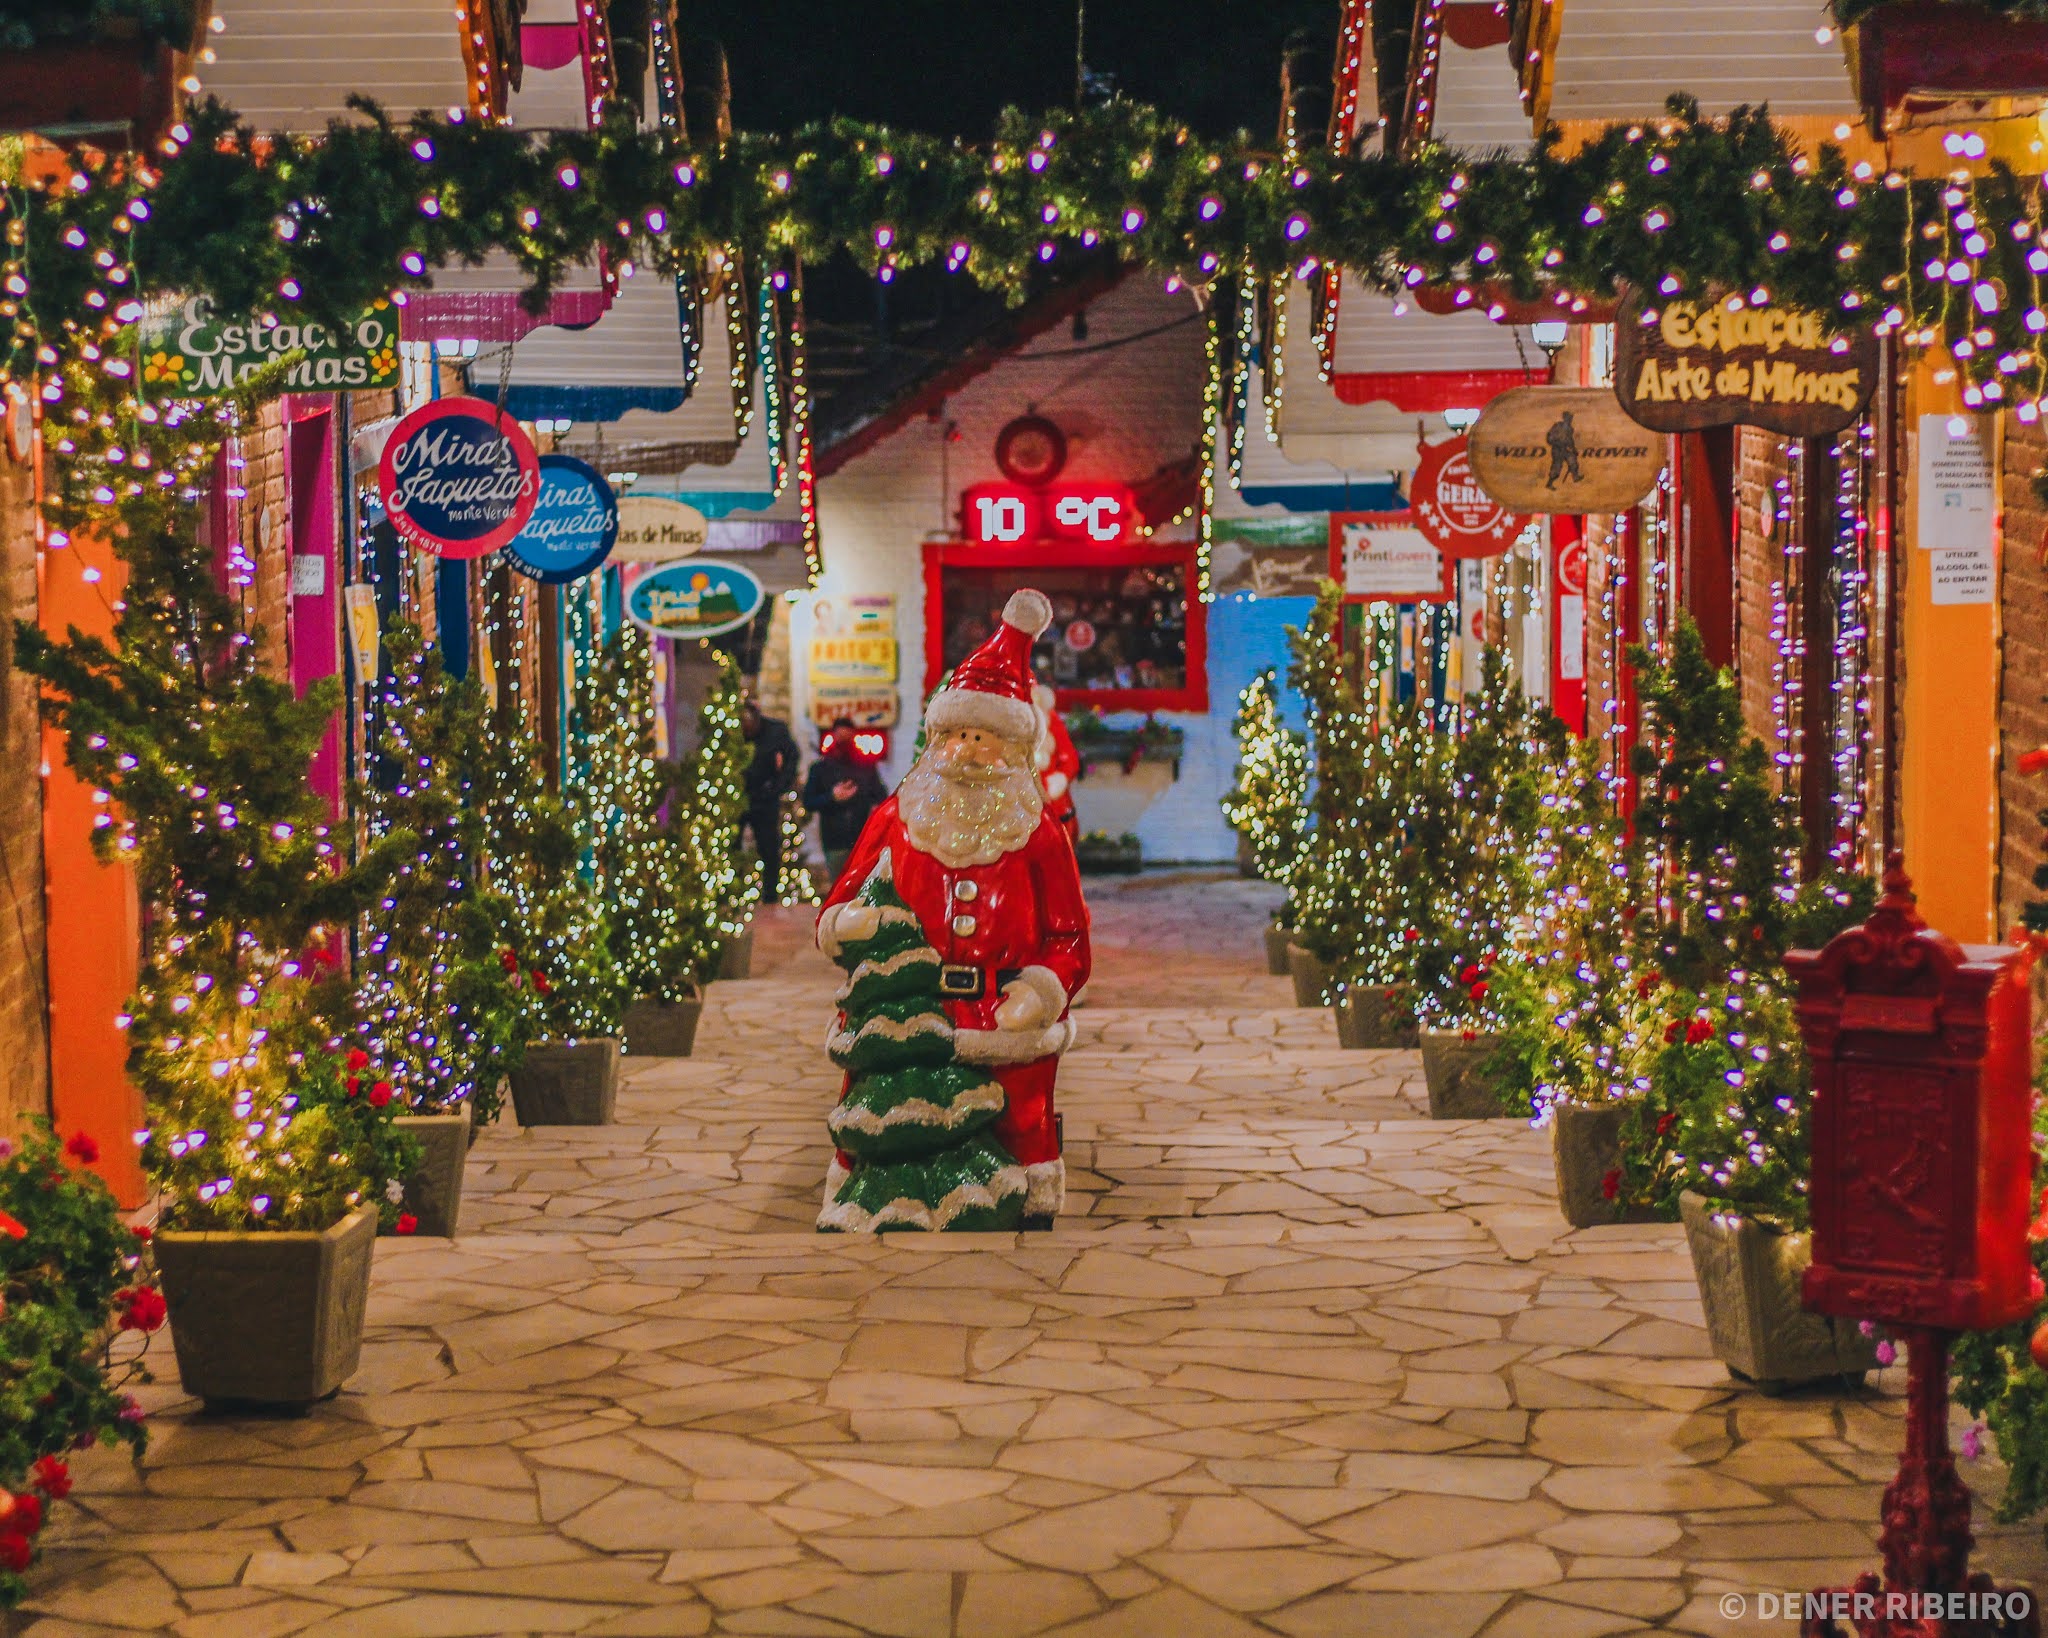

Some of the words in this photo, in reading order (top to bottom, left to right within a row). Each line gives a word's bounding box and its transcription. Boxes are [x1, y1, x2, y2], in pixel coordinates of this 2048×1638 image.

[1635, 356, 1712, 402] Arte
[1715, 361, 1750, 396] de
[1750, 360, 1860, 412] Minas
[1494, 446, 1547, 458] WILD
[1581, 446, 1648, 458] ROVER
[388, 463, 534, 513] Jaquetas
[641, 525, 658, 544] de
[661, 523, 703, 544] Minas
[976, 497, 1025, 542] 10
[1352, 550, 1434, 564] PrintLovers
